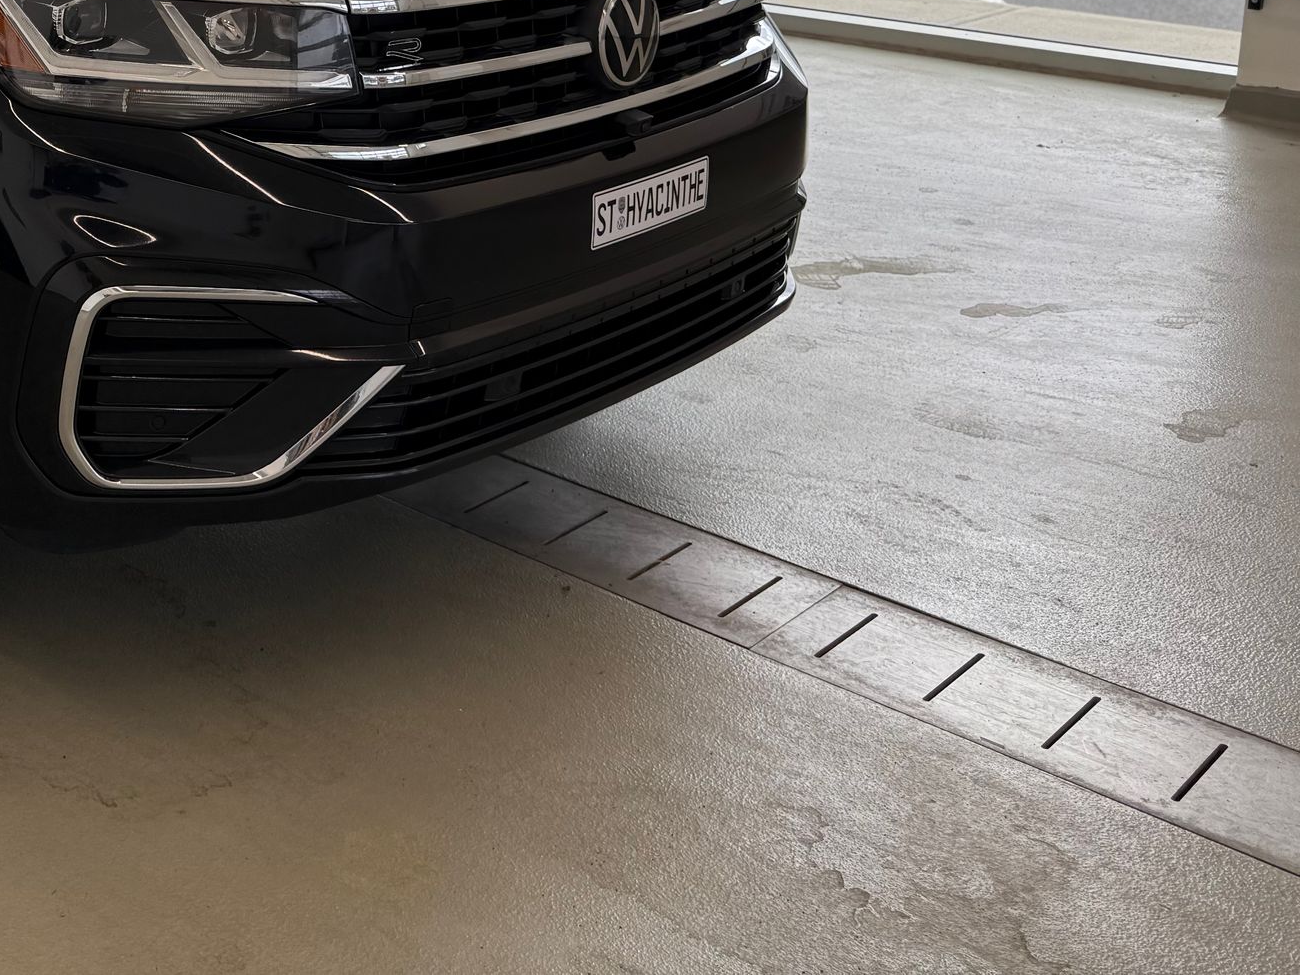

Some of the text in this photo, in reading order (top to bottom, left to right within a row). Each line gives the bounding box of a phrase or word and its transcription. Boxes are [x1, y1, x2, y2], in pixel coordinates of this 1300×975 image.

[385, 37, 425, 62] R
[596, 168, 705, 236] ST HYACINTHE
